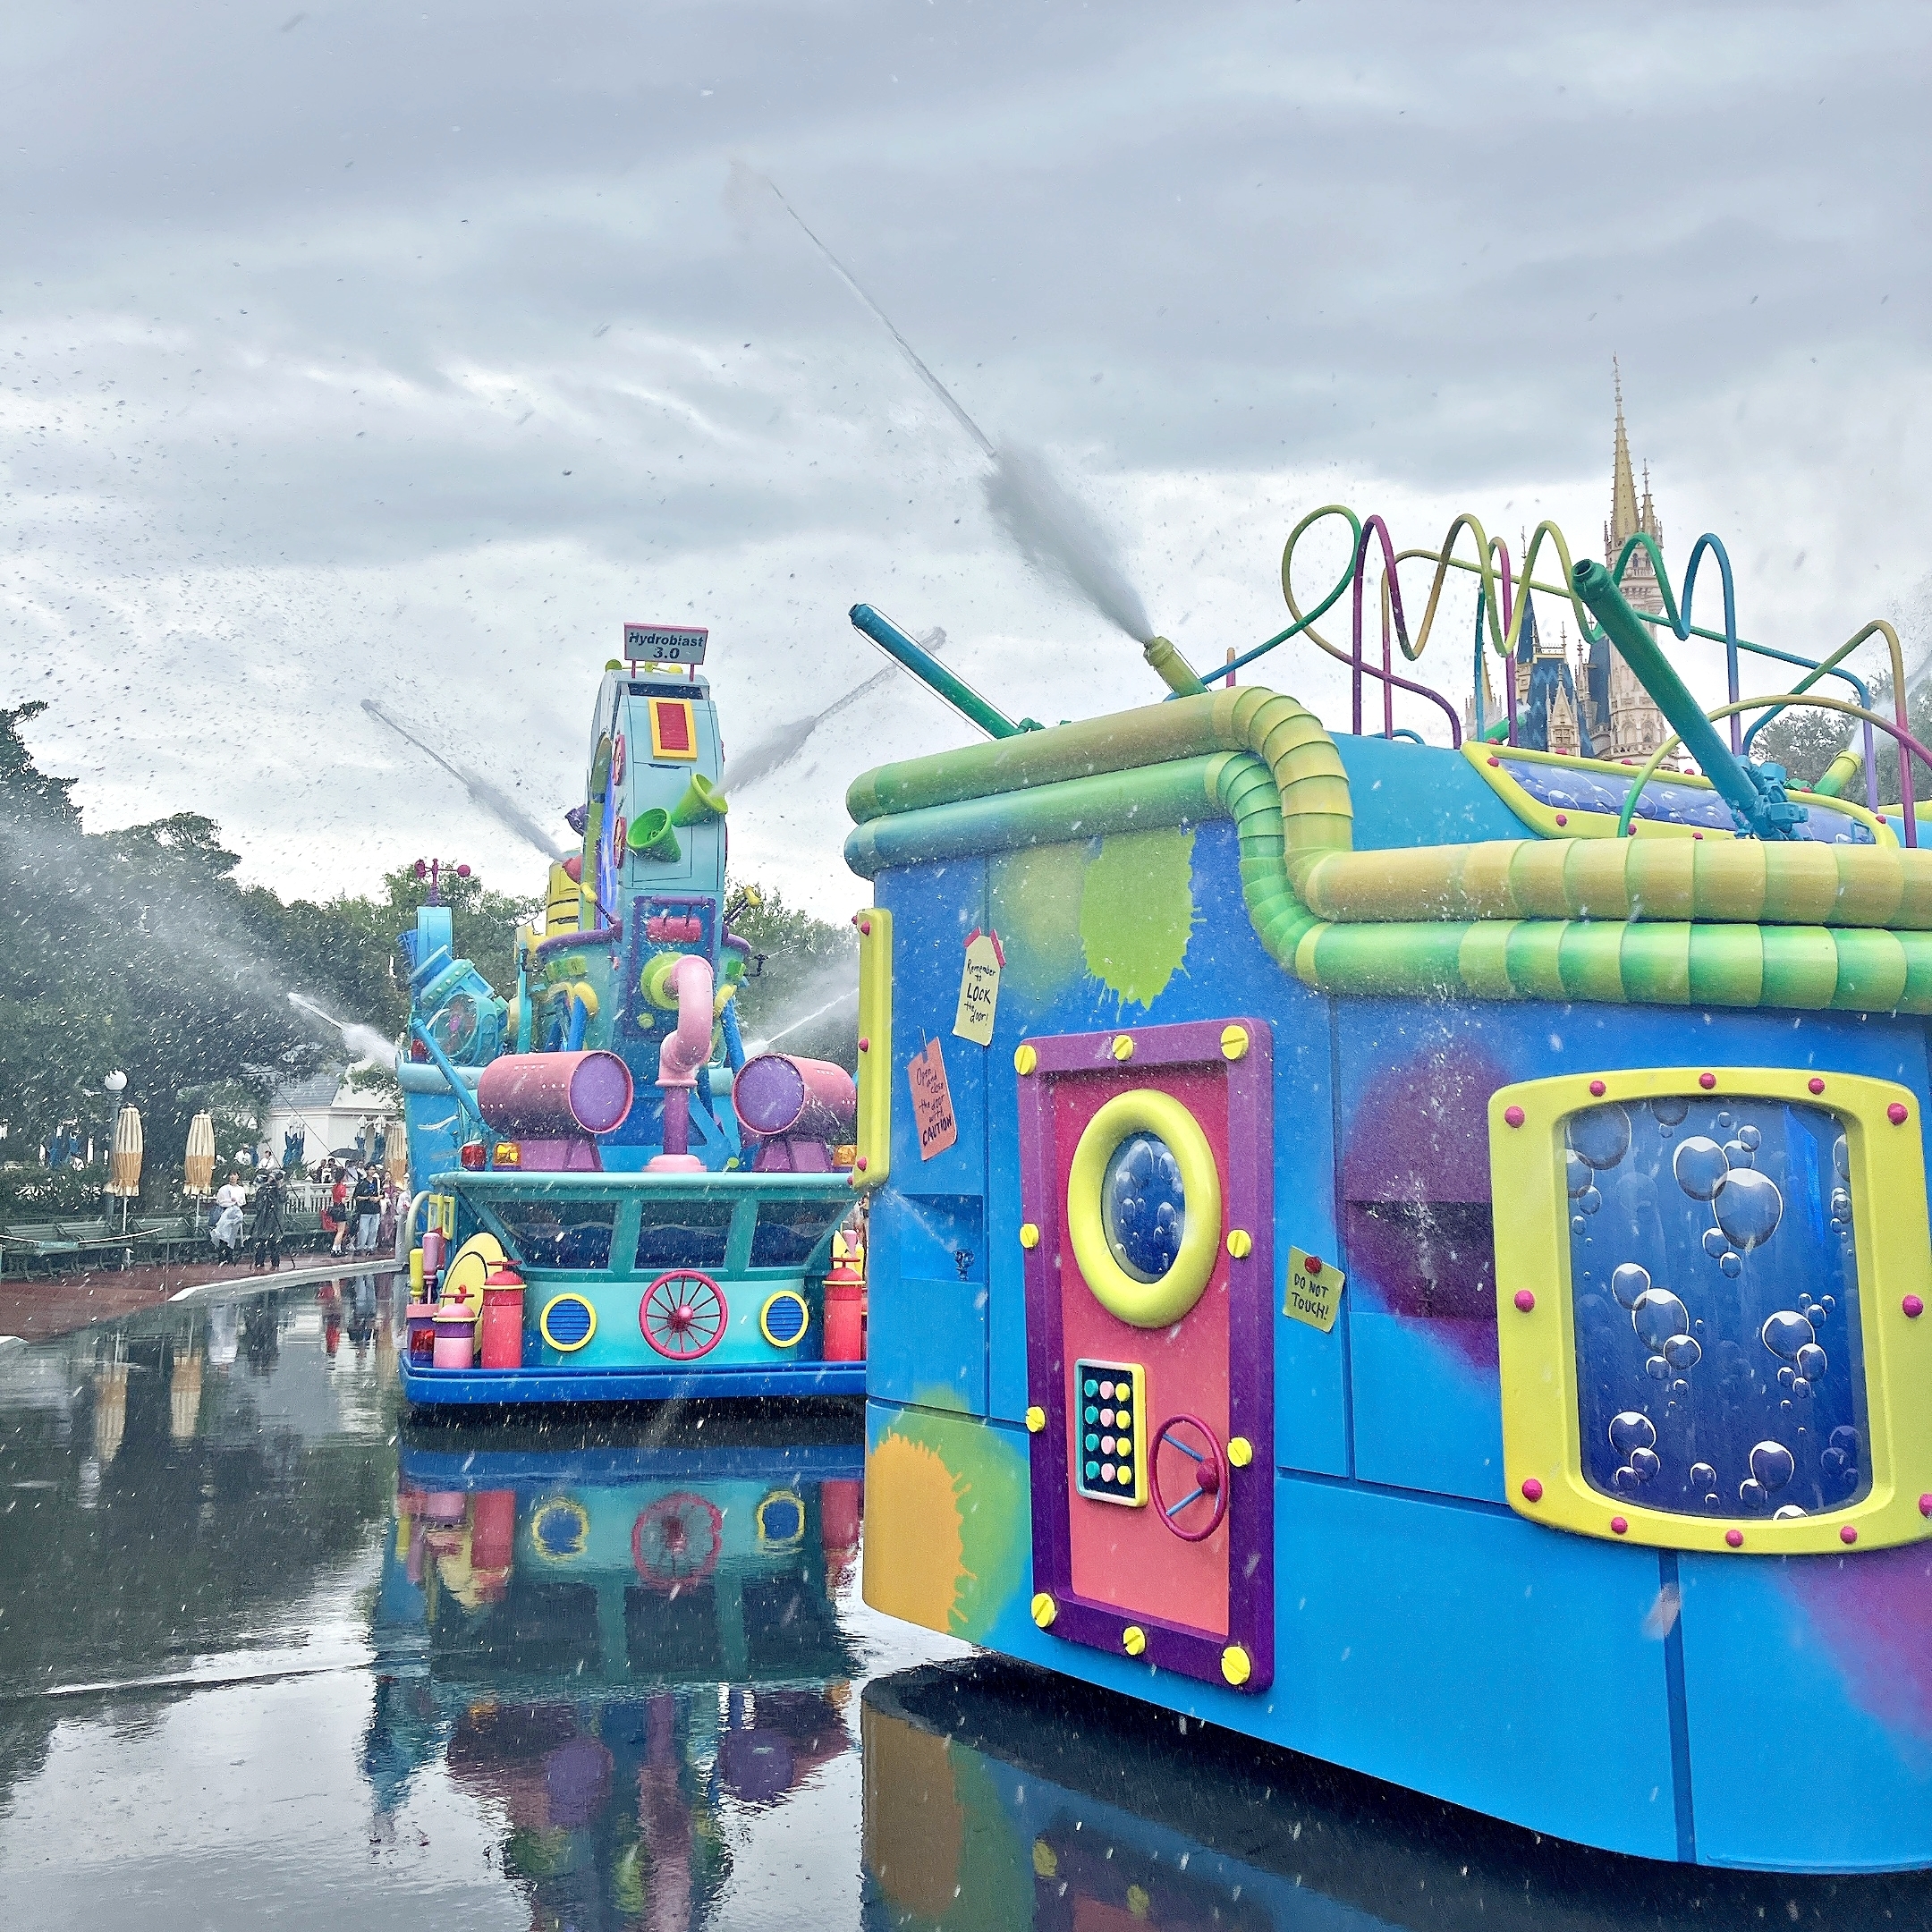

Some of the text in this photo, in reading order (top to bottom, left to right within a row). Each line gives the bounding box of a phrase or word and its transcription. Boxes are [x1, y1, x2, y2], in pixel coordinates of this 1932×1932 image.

[629, 631, 704, 647] Hydroblast
[653, 647, 680, 659] 3.0
[967, 958, 996, 976] Remember
[967, 983, 991, 1004] LOCK
[964, 1002, 975, 1012] the
[917, 1067, 931, 1086] Open
[927, 1070, 937, 1087] and
[919, 1094, 945, 1114] the door
[928, 1106, 944, 1123] with
[922, 1115, 952, 1146] CAUTION
[1294, 1273, 1329, 1298] DO NOT
[1291, 1292, 1329, 1320] TOUCH!
